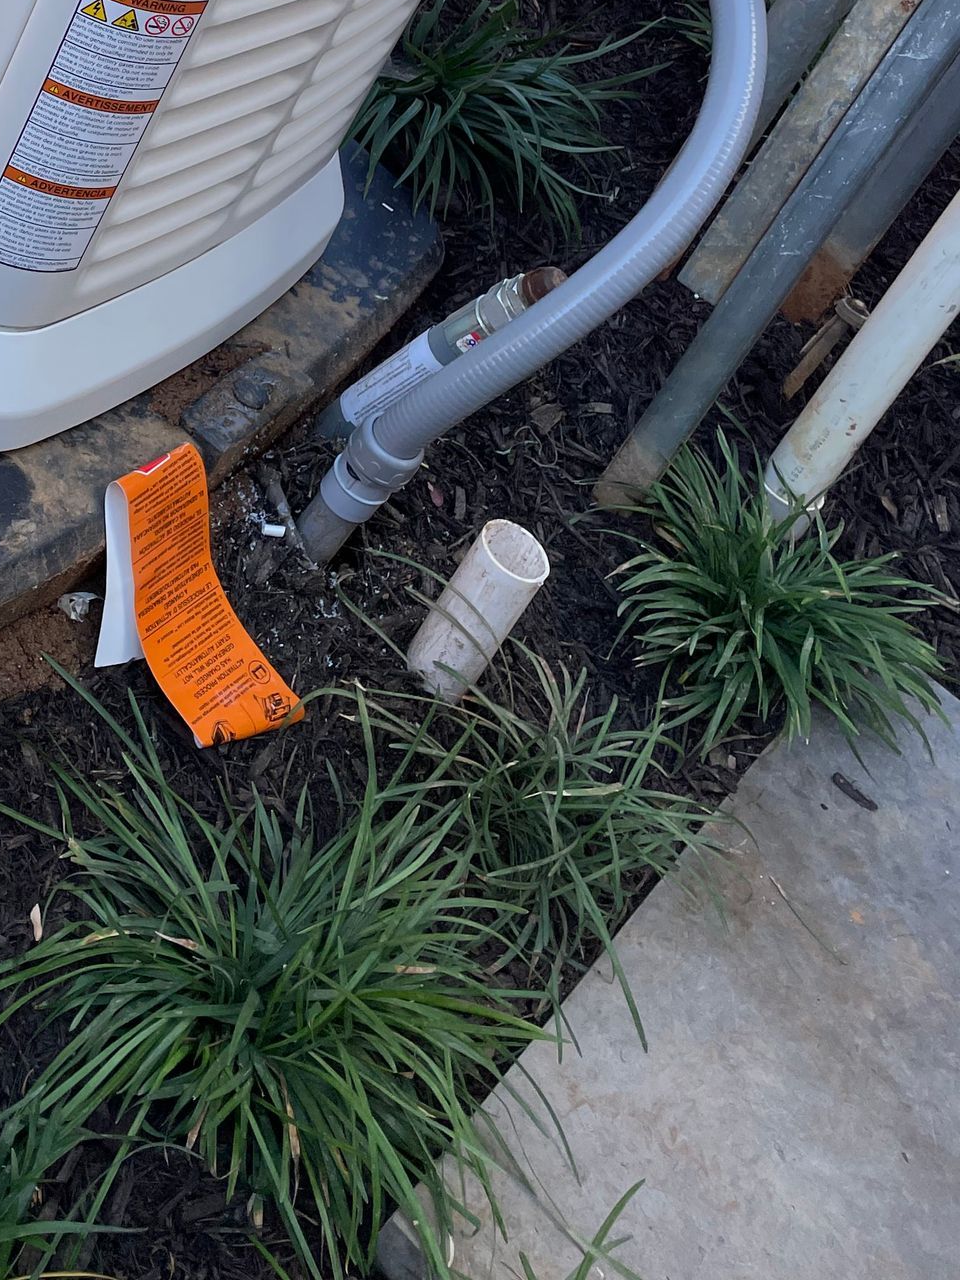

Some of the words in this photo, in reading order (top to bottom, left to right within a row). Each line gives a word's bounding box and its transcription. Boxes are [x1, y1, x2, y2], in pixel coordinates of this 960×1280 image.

[62, 89, 156, 113] AVERTISSEMENT
[30, 180, 108, 199] ADVERTENCIA
[214, 633, 230, 648] START
[204, 643, 234, 666] GENERATOR
[220, 658, 231, 667] HAS
[182, 673, 192, 684] NOT
[192, 664, 204, 675] WILL
[216, 658, 244, 681] ACTIVATION
[193, 679, 217, 699] PROCESS
